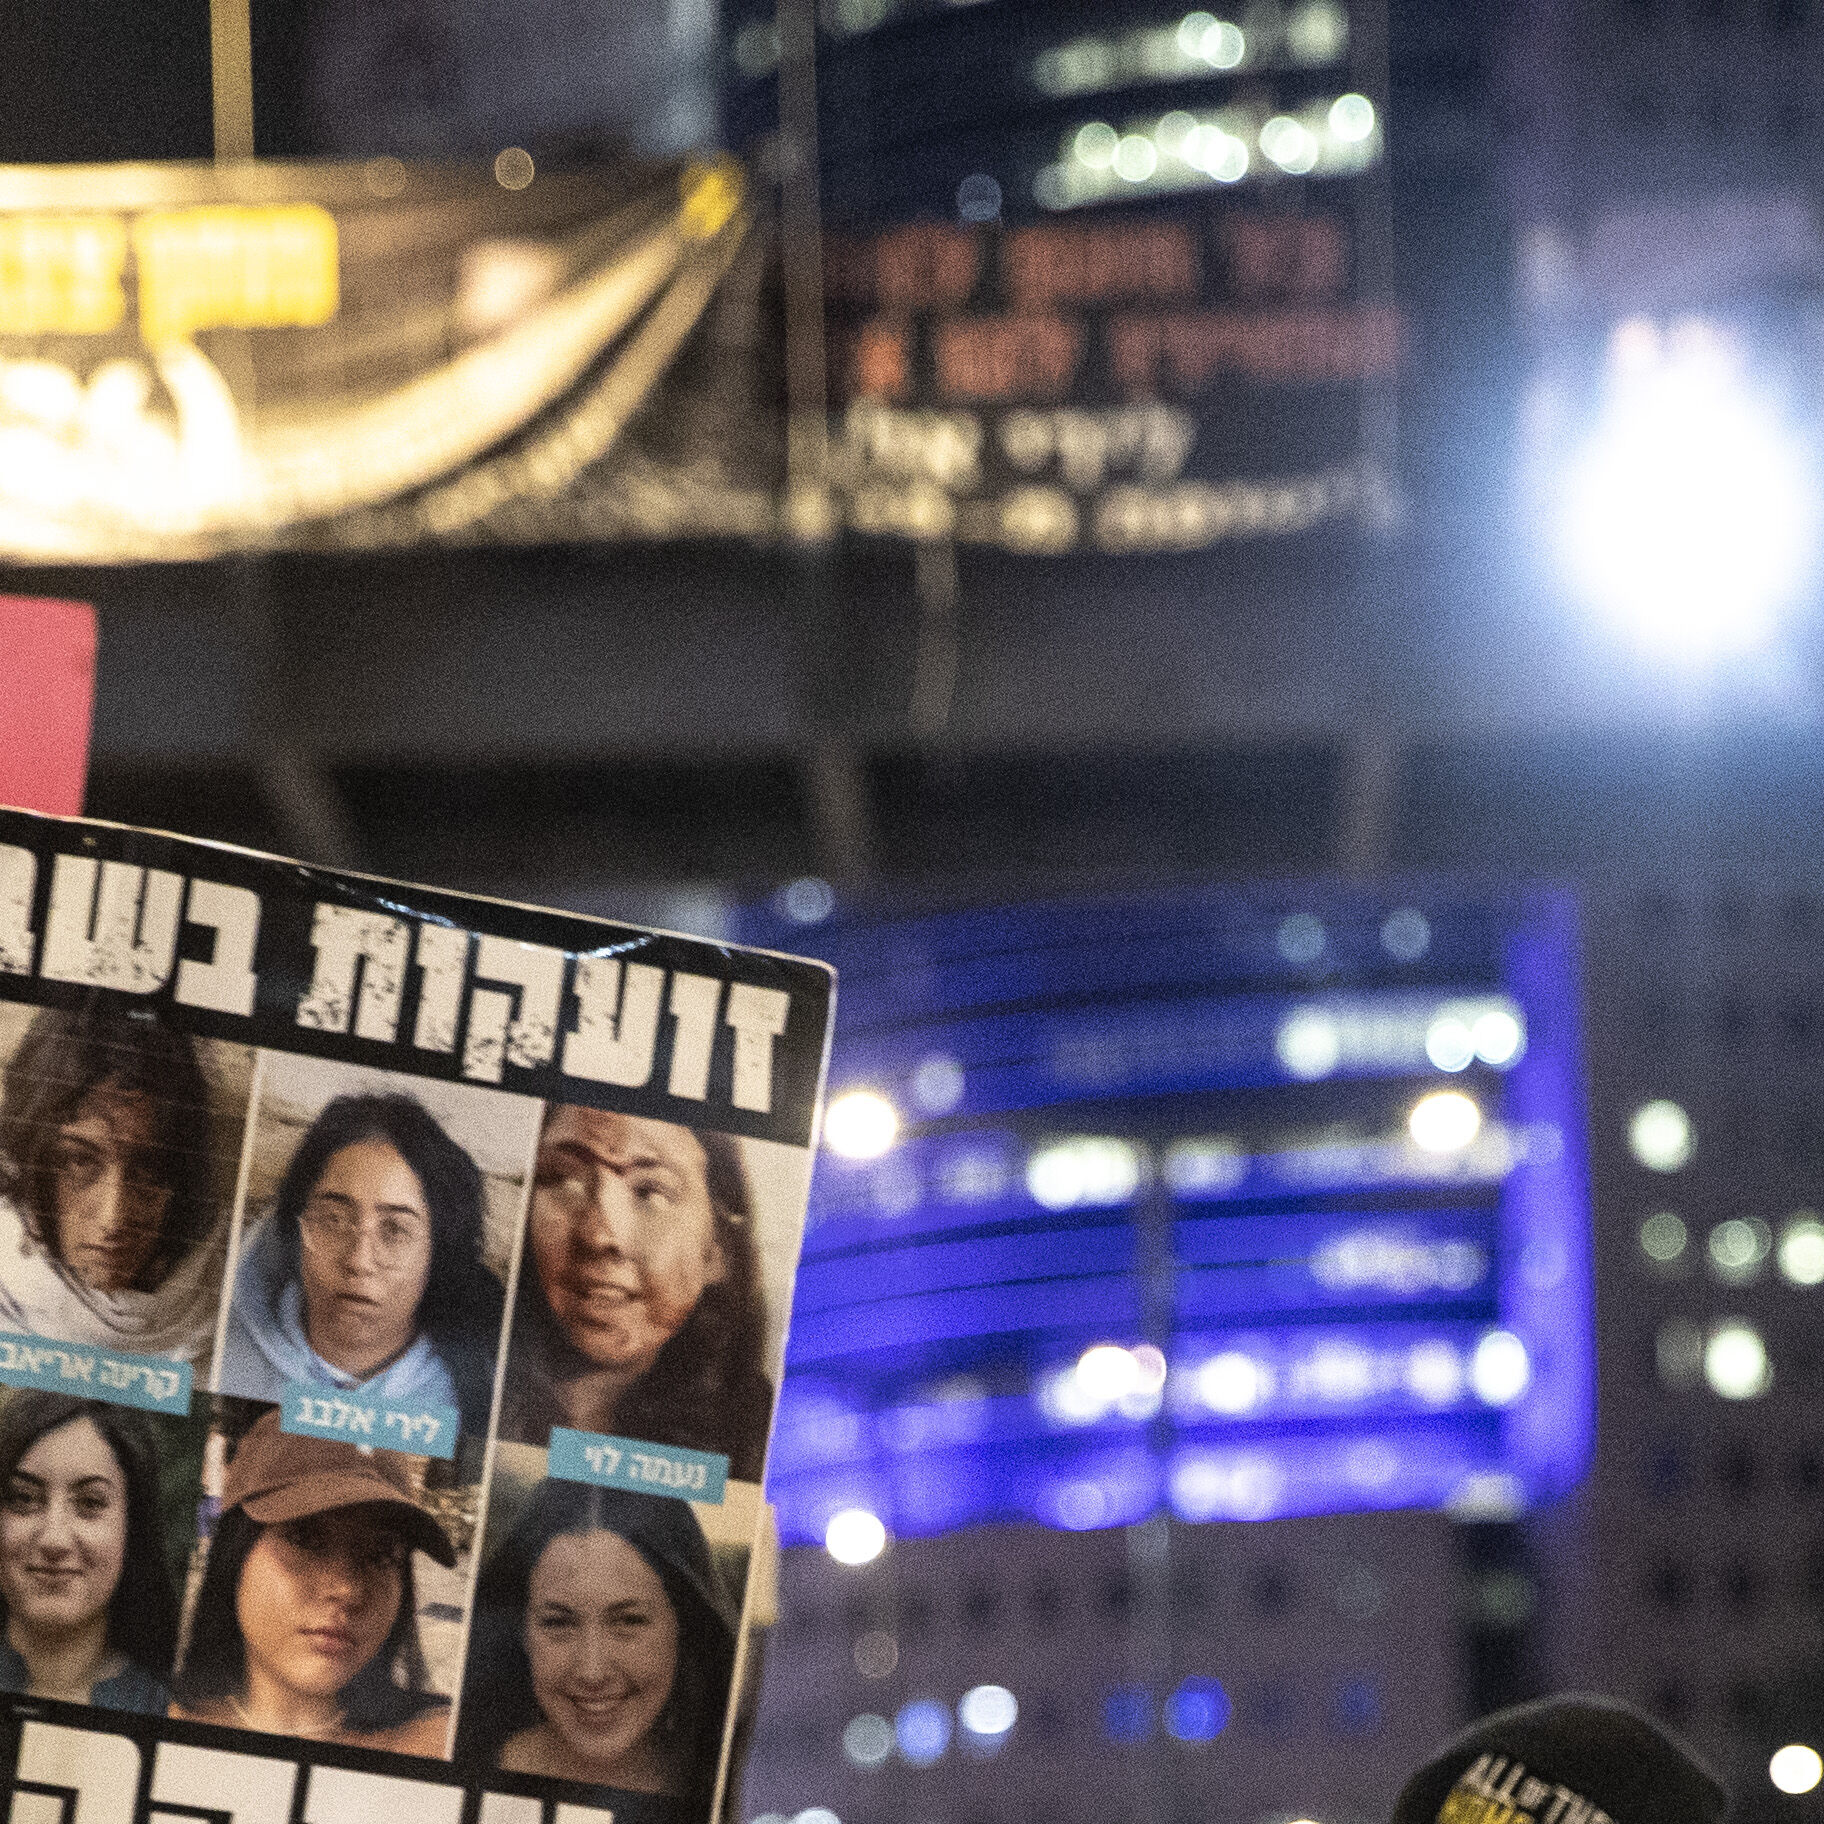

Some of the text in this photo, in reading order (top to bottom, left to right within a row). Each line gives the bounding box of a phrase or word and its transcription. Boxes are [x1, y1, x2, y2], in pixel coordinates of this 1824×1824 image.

[295, 898, 791, 1114] זועקות
[99, 1358, 180, 1400] קרינה
[384, 1411, 441, 1445] לירי
[584, 1445, 708, 1490] נעמה לוי
[1456, 1752, 1526, 1804] ALL
